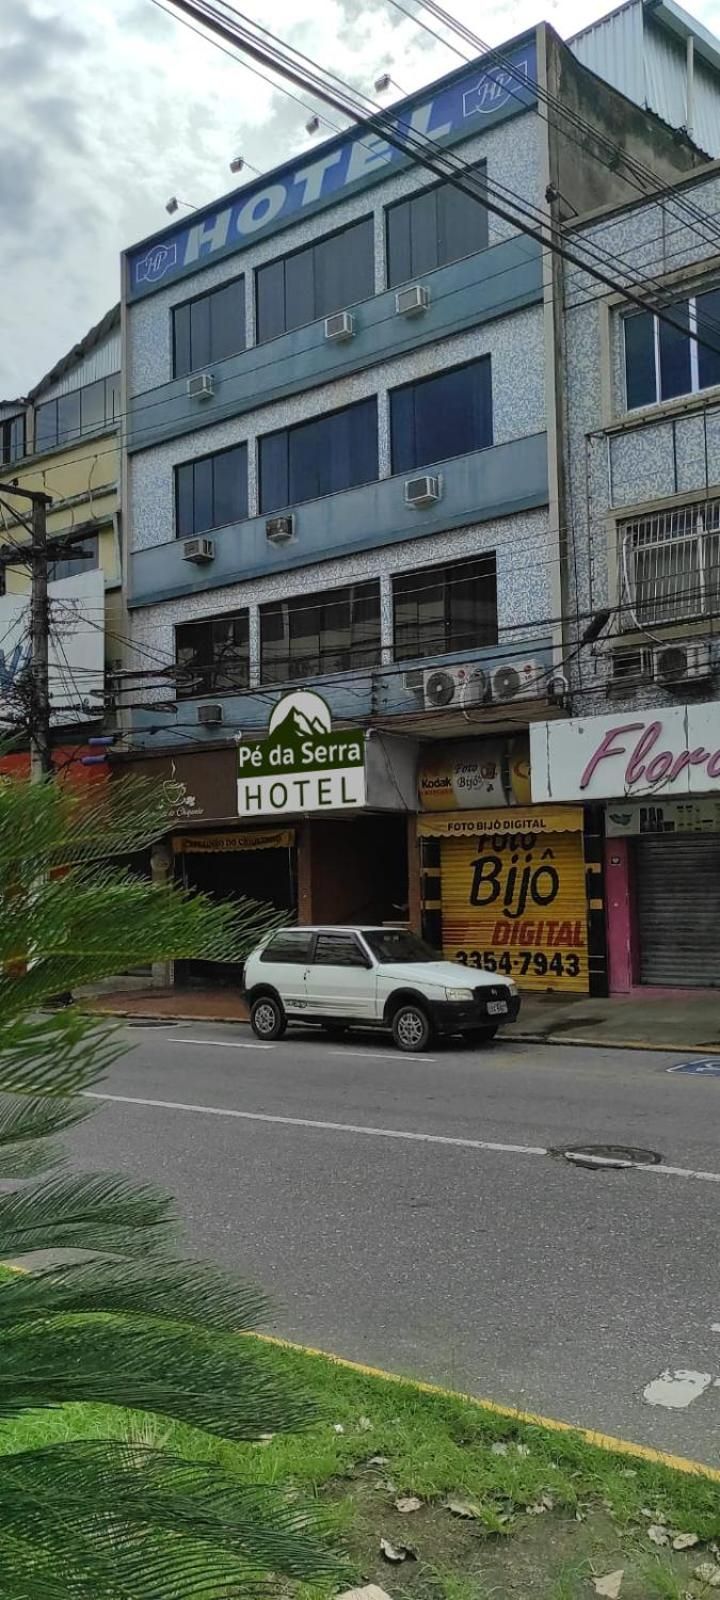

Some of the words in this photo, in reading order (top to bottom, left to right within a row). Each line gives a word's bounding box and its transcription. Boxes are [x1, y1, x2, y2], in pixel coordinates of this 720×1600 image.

[183, 103, 452, 266] HOTEL
[239, 745, 263, 768] Pé
[269, 744, 294, 766] da
[301, 741, 360, 764] Serra
[245, 776, 357, 811] HOTEL
[421, 776, 452, 789] Kodak
[447, 822, 475, 832] FOTO
[503, 818, 547, 830] DIGITAL
[469, 848, 560, 919] Bijô
[491, 920, 585, 947] DIGITAL
